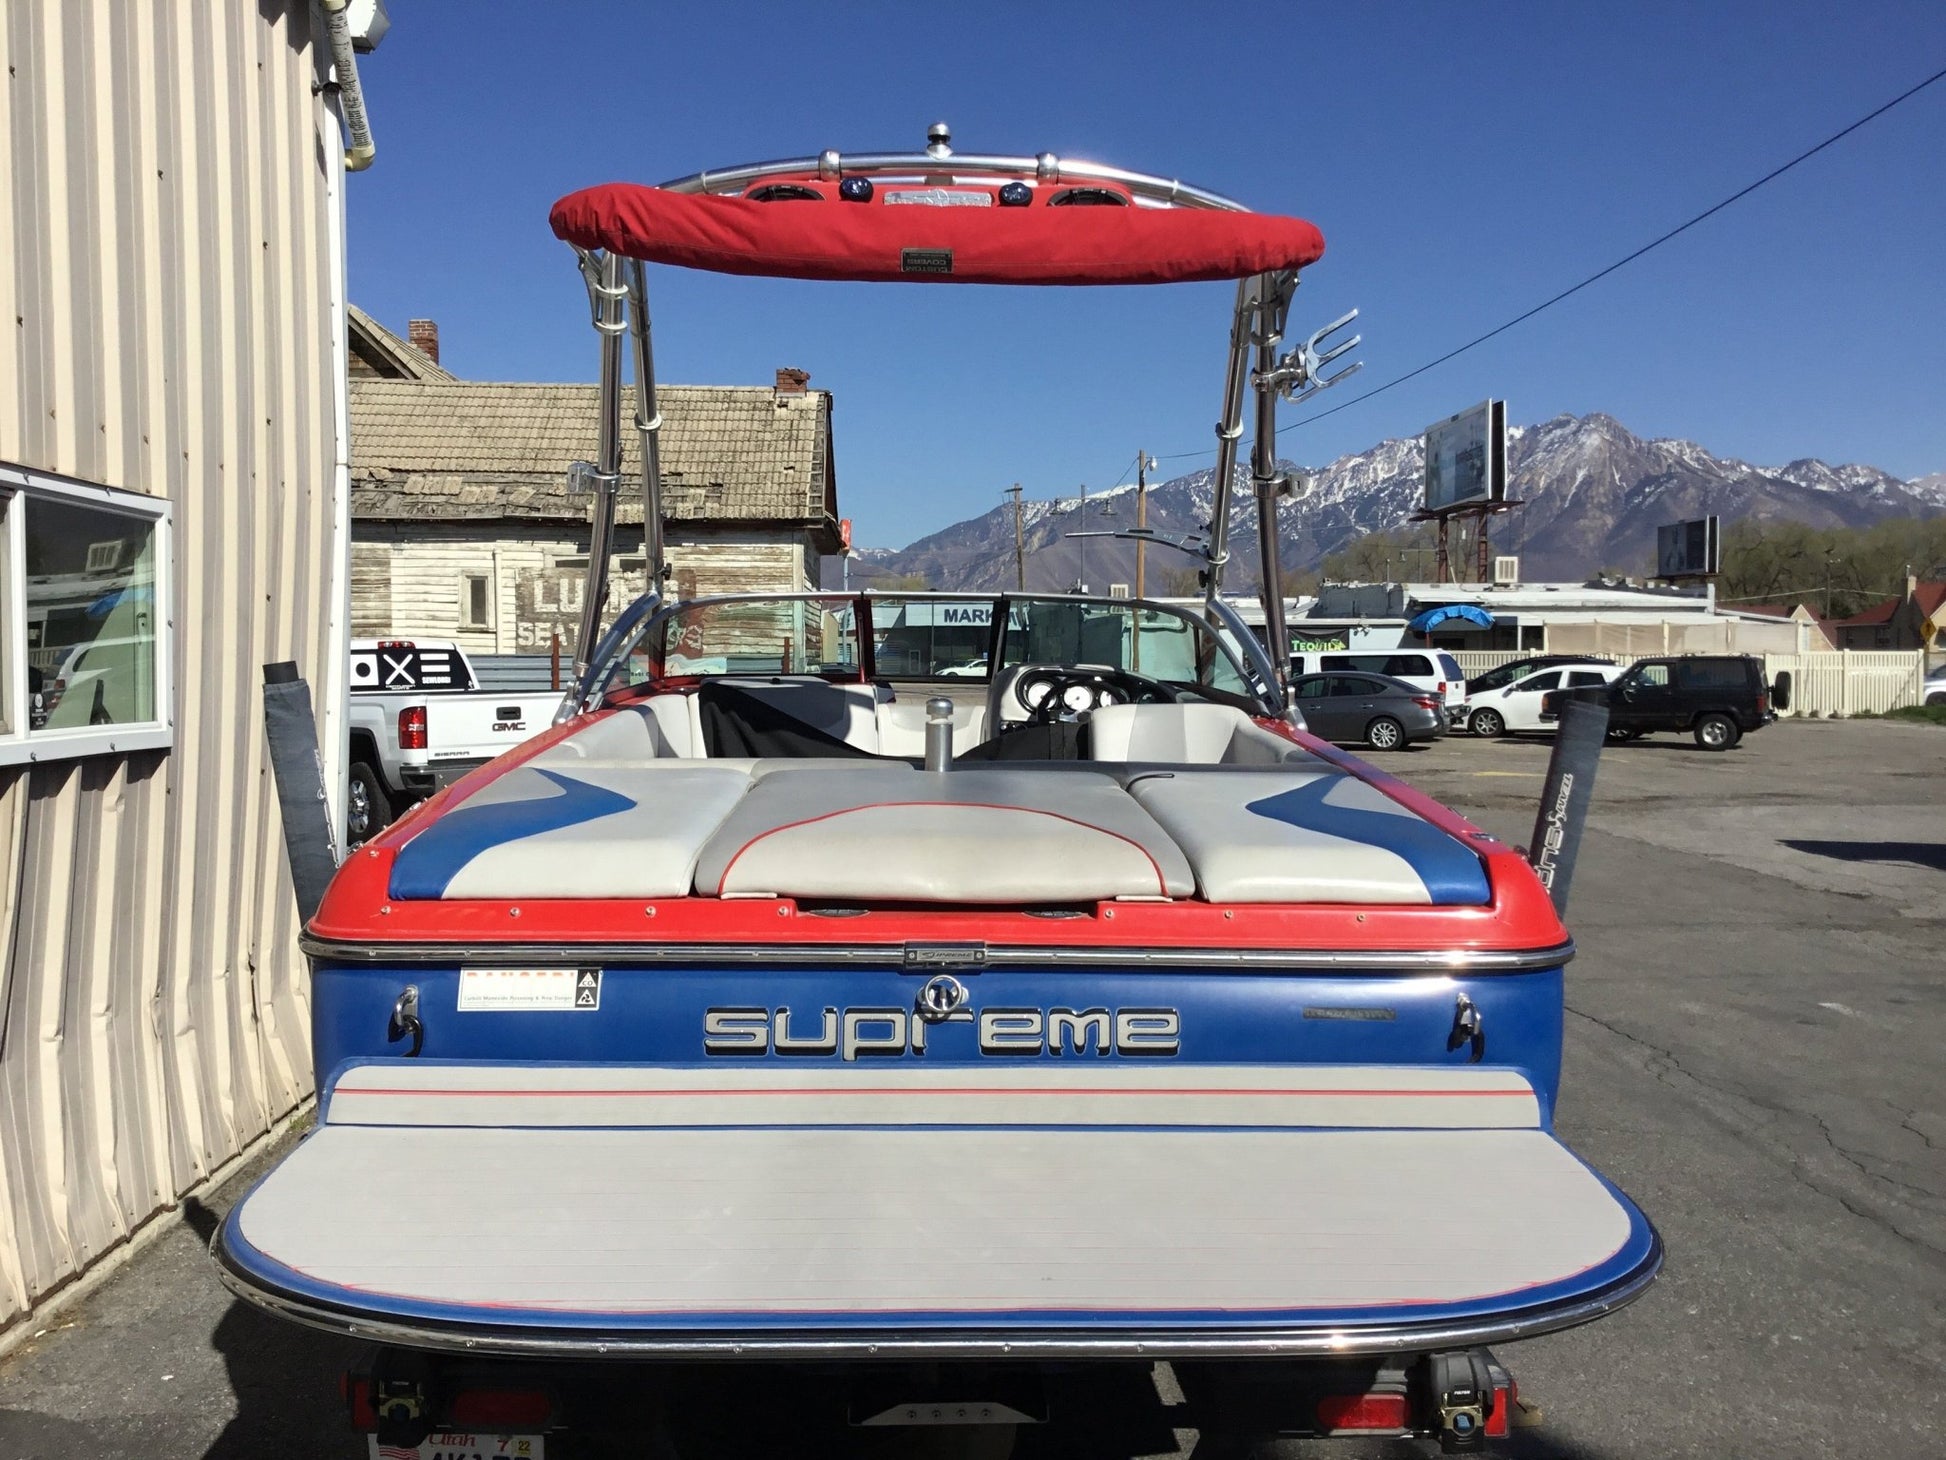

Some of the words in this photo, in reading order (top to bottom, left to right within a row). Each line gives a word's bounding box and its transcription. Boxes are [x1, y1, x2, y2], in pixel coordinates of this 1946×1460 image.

[492, 722, 526, 732] GMC
[428, 1433, 477, 1447] Utah
[497, 1440, 509, 1452] 7
[519, 1440, 531, 1451] 22
